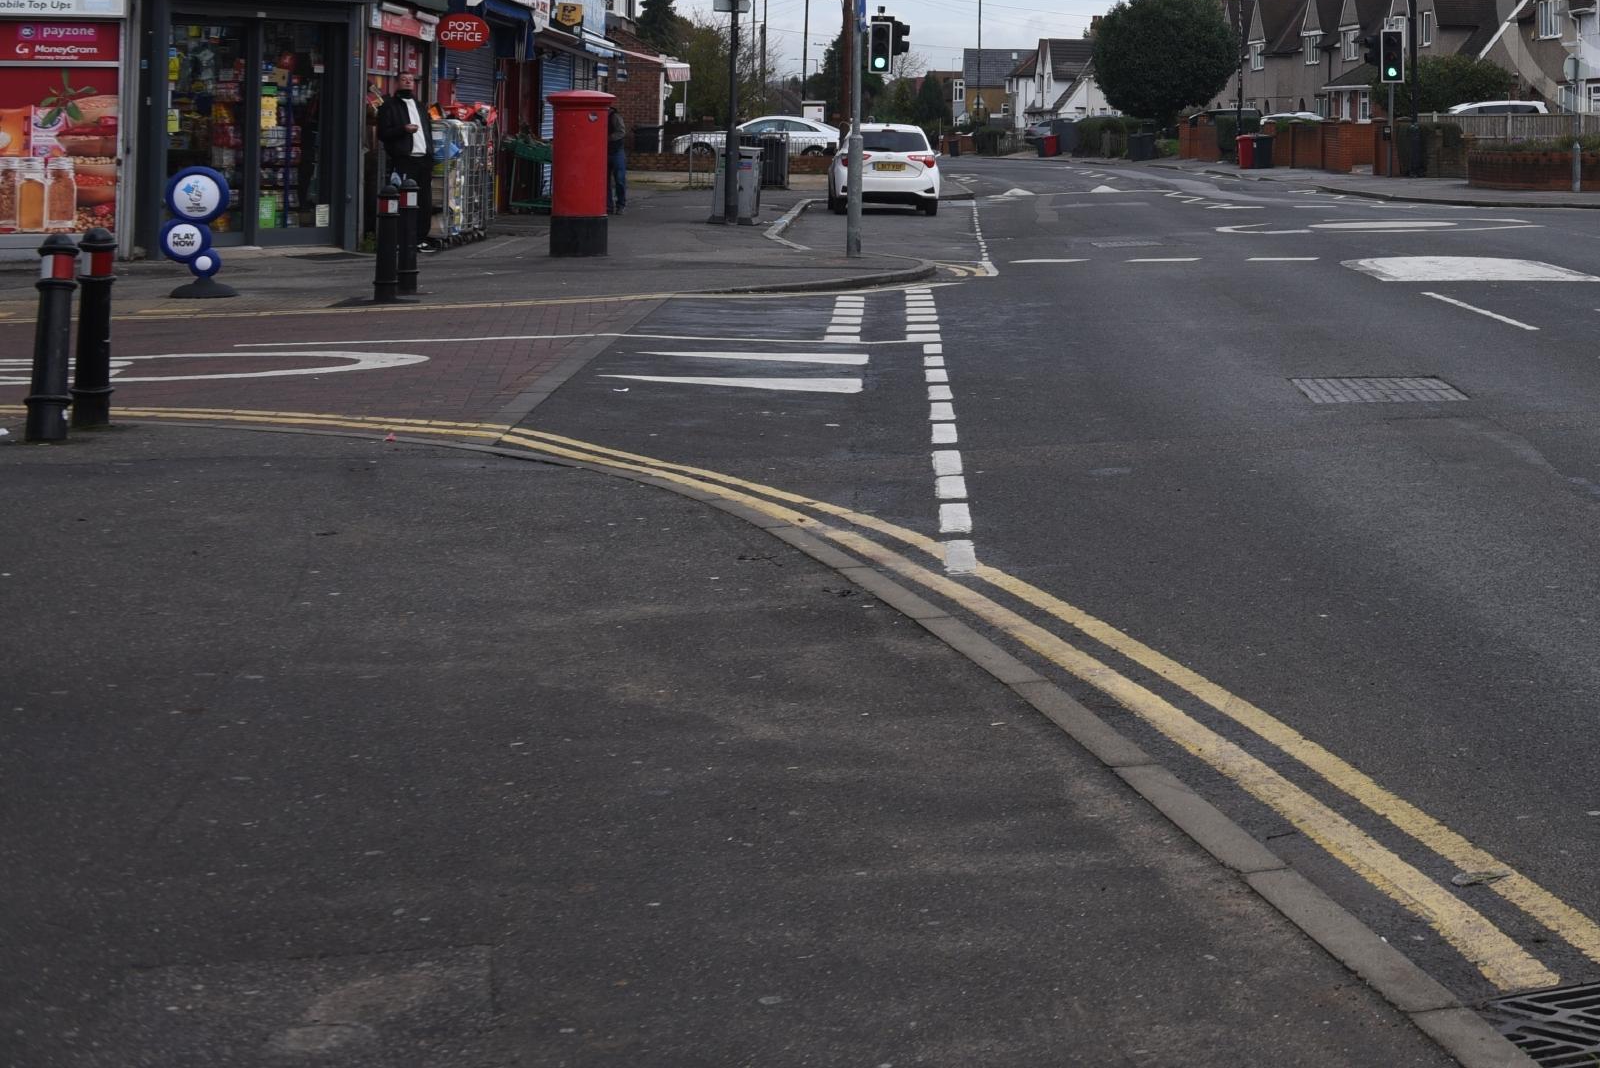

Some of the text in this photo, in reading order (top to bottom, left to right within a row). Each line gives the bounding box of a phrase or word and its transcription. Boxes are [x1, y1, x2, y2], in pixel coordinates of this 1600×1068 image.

[28, 0, 47, 10] Top
[51, 1, 72, 11] Ups
[448, 21, 479, 31] POST
[43, 27, 95, 38] payzone
[440, 31, 483, 42] OFFICE
[34, 44, 97, 55] MoneyGram
[173, 233, 195, 241] PLAY
